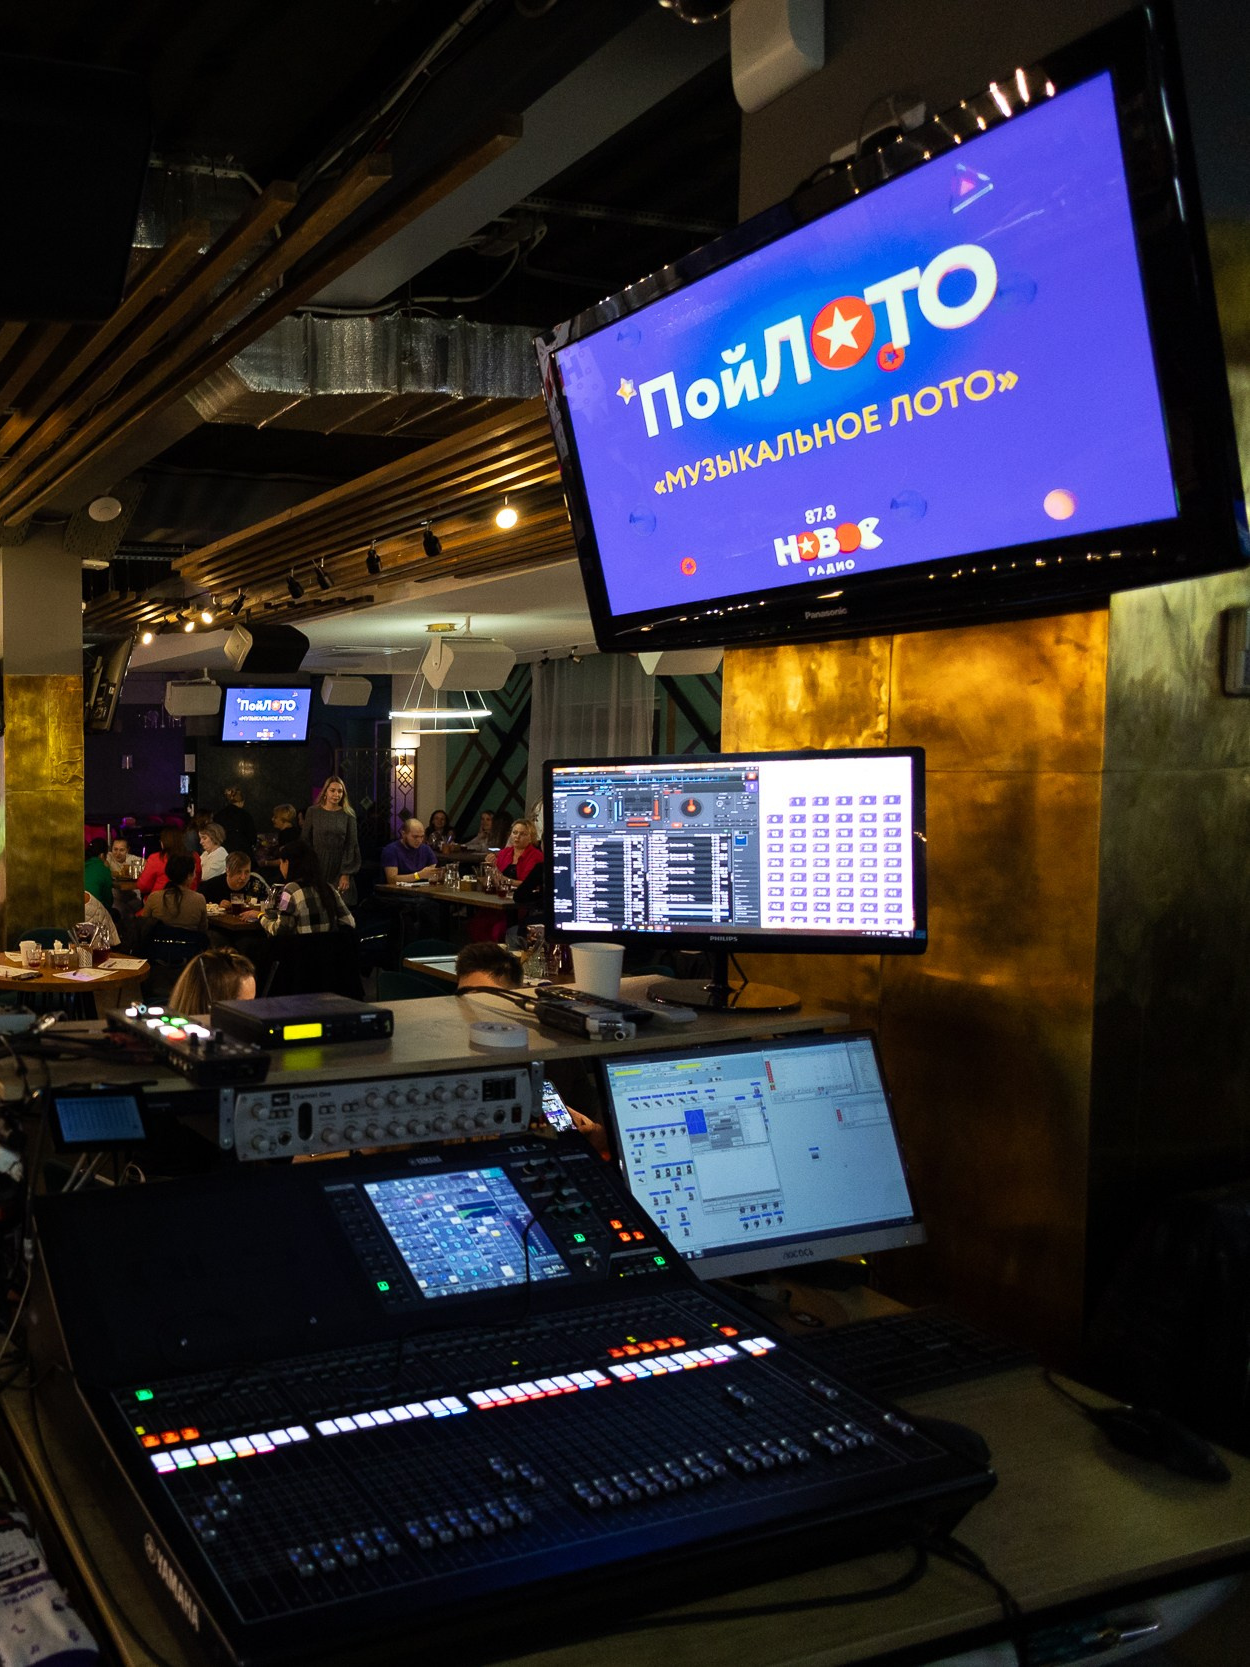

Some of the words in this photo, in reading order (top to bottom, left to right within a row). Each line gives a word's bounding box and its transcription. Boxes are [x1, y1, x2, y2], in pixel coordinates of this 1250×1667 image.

[637, 244, 998, 438] ПойЛОТО
[653, 405, 882, 496] «МУЗЫКАЛЬНОЕ
[888, 369, 1019, 428] ЛОТО»
[805, 504, 837, 525] 87.8
[808, 559, 856, 577] РАДИО
[804, 606, 848, 620] Panasonic
[239, 699, 297, 712] ПойЛОТО
[709, 935, 738, 943] PHILIPS
[155, 1547, 200, 1633] YAMAHA
